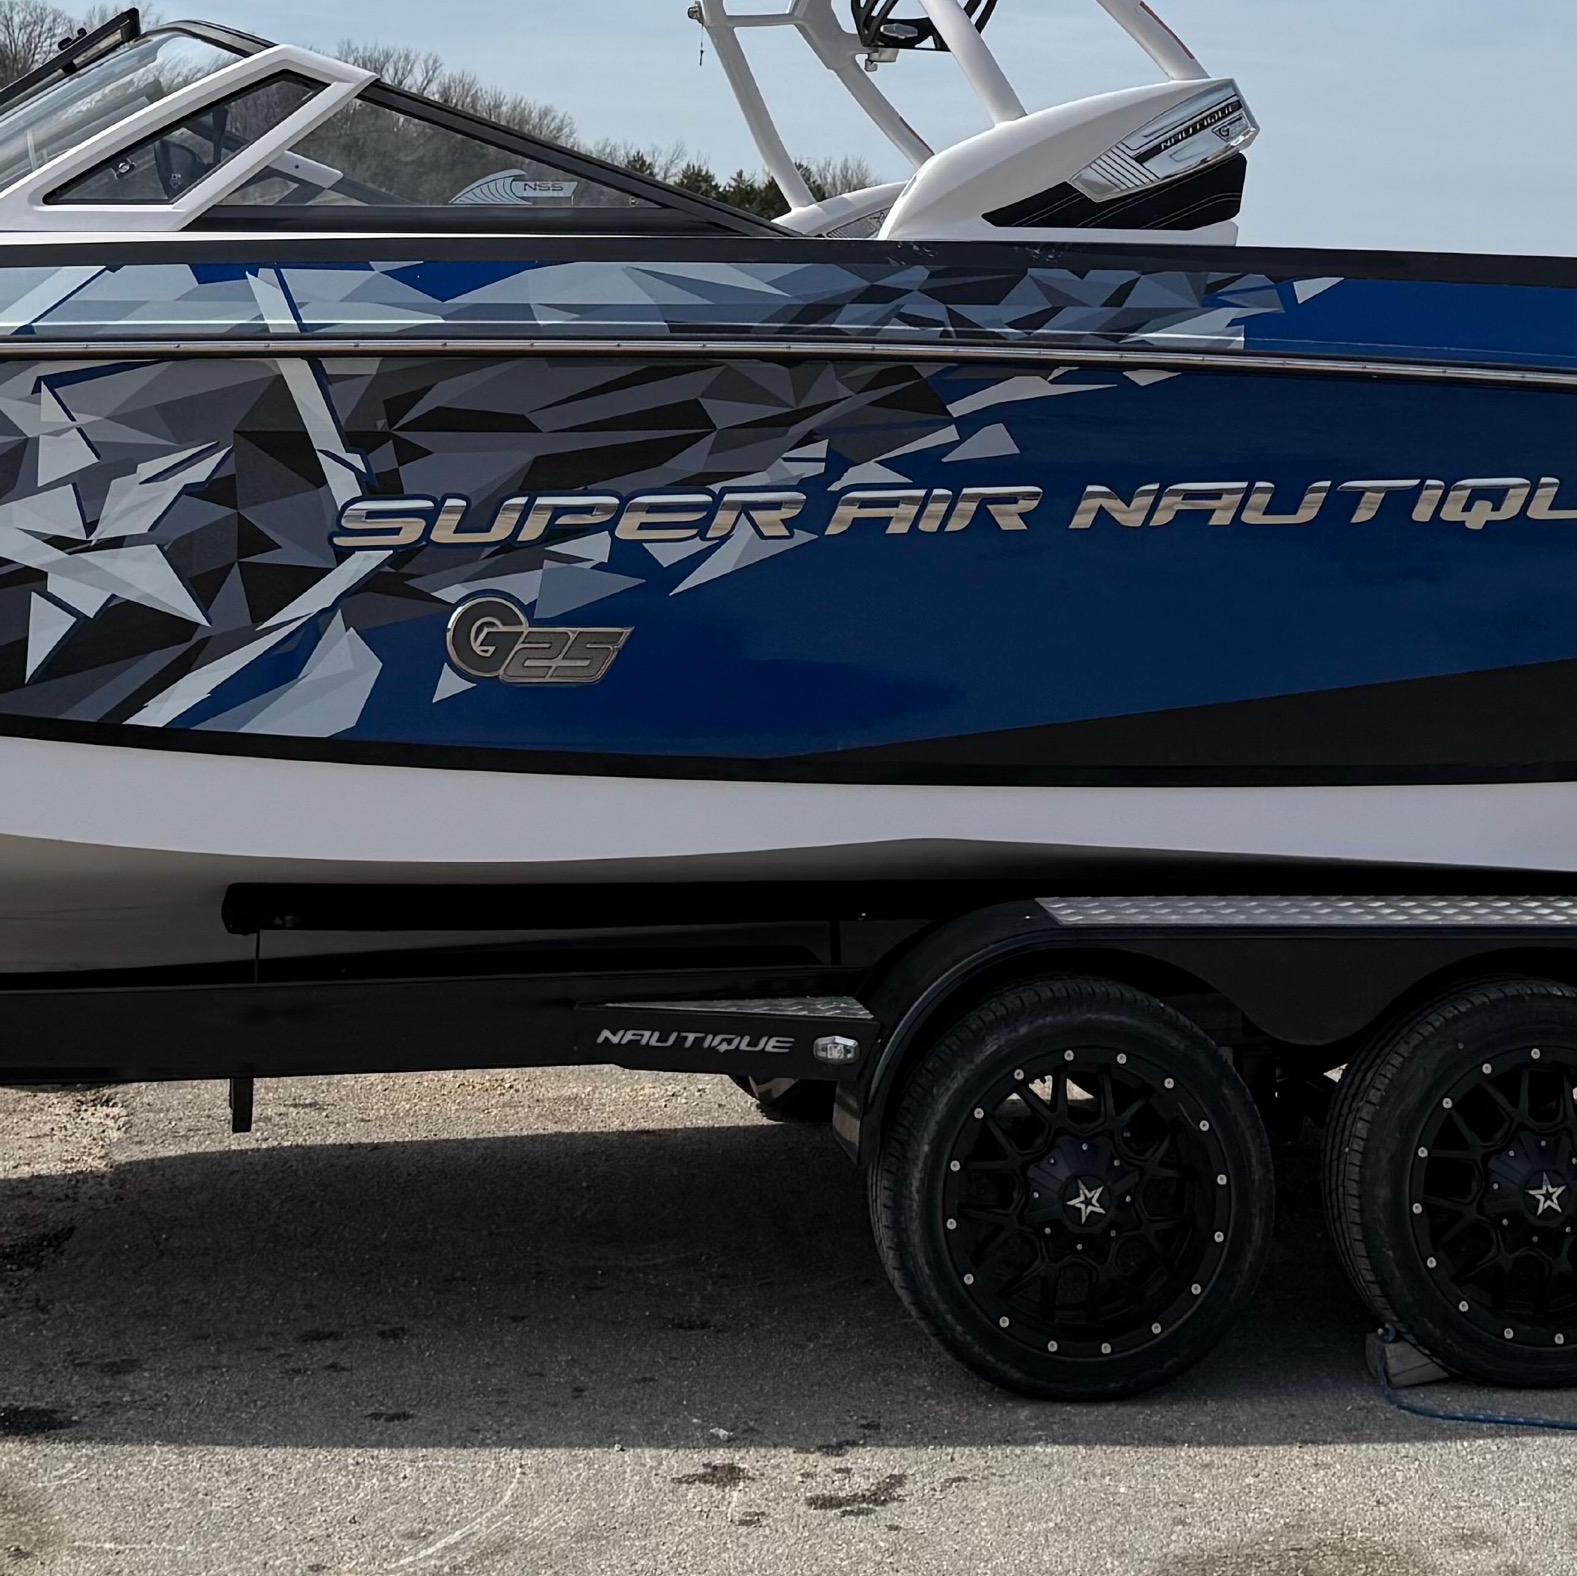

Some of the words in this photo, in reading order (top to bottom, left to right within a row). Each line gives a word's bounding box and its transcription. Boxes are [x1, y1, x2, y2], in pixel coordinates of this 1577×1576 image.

[523, 182, 564, 192] NSS
[332, 491, 807, 548] SUPER
[825, 485, 1044, 537] AIR
[445, 595, 636, 685] G25
[596, 1027, 796, 1054] NAUTIQUE
